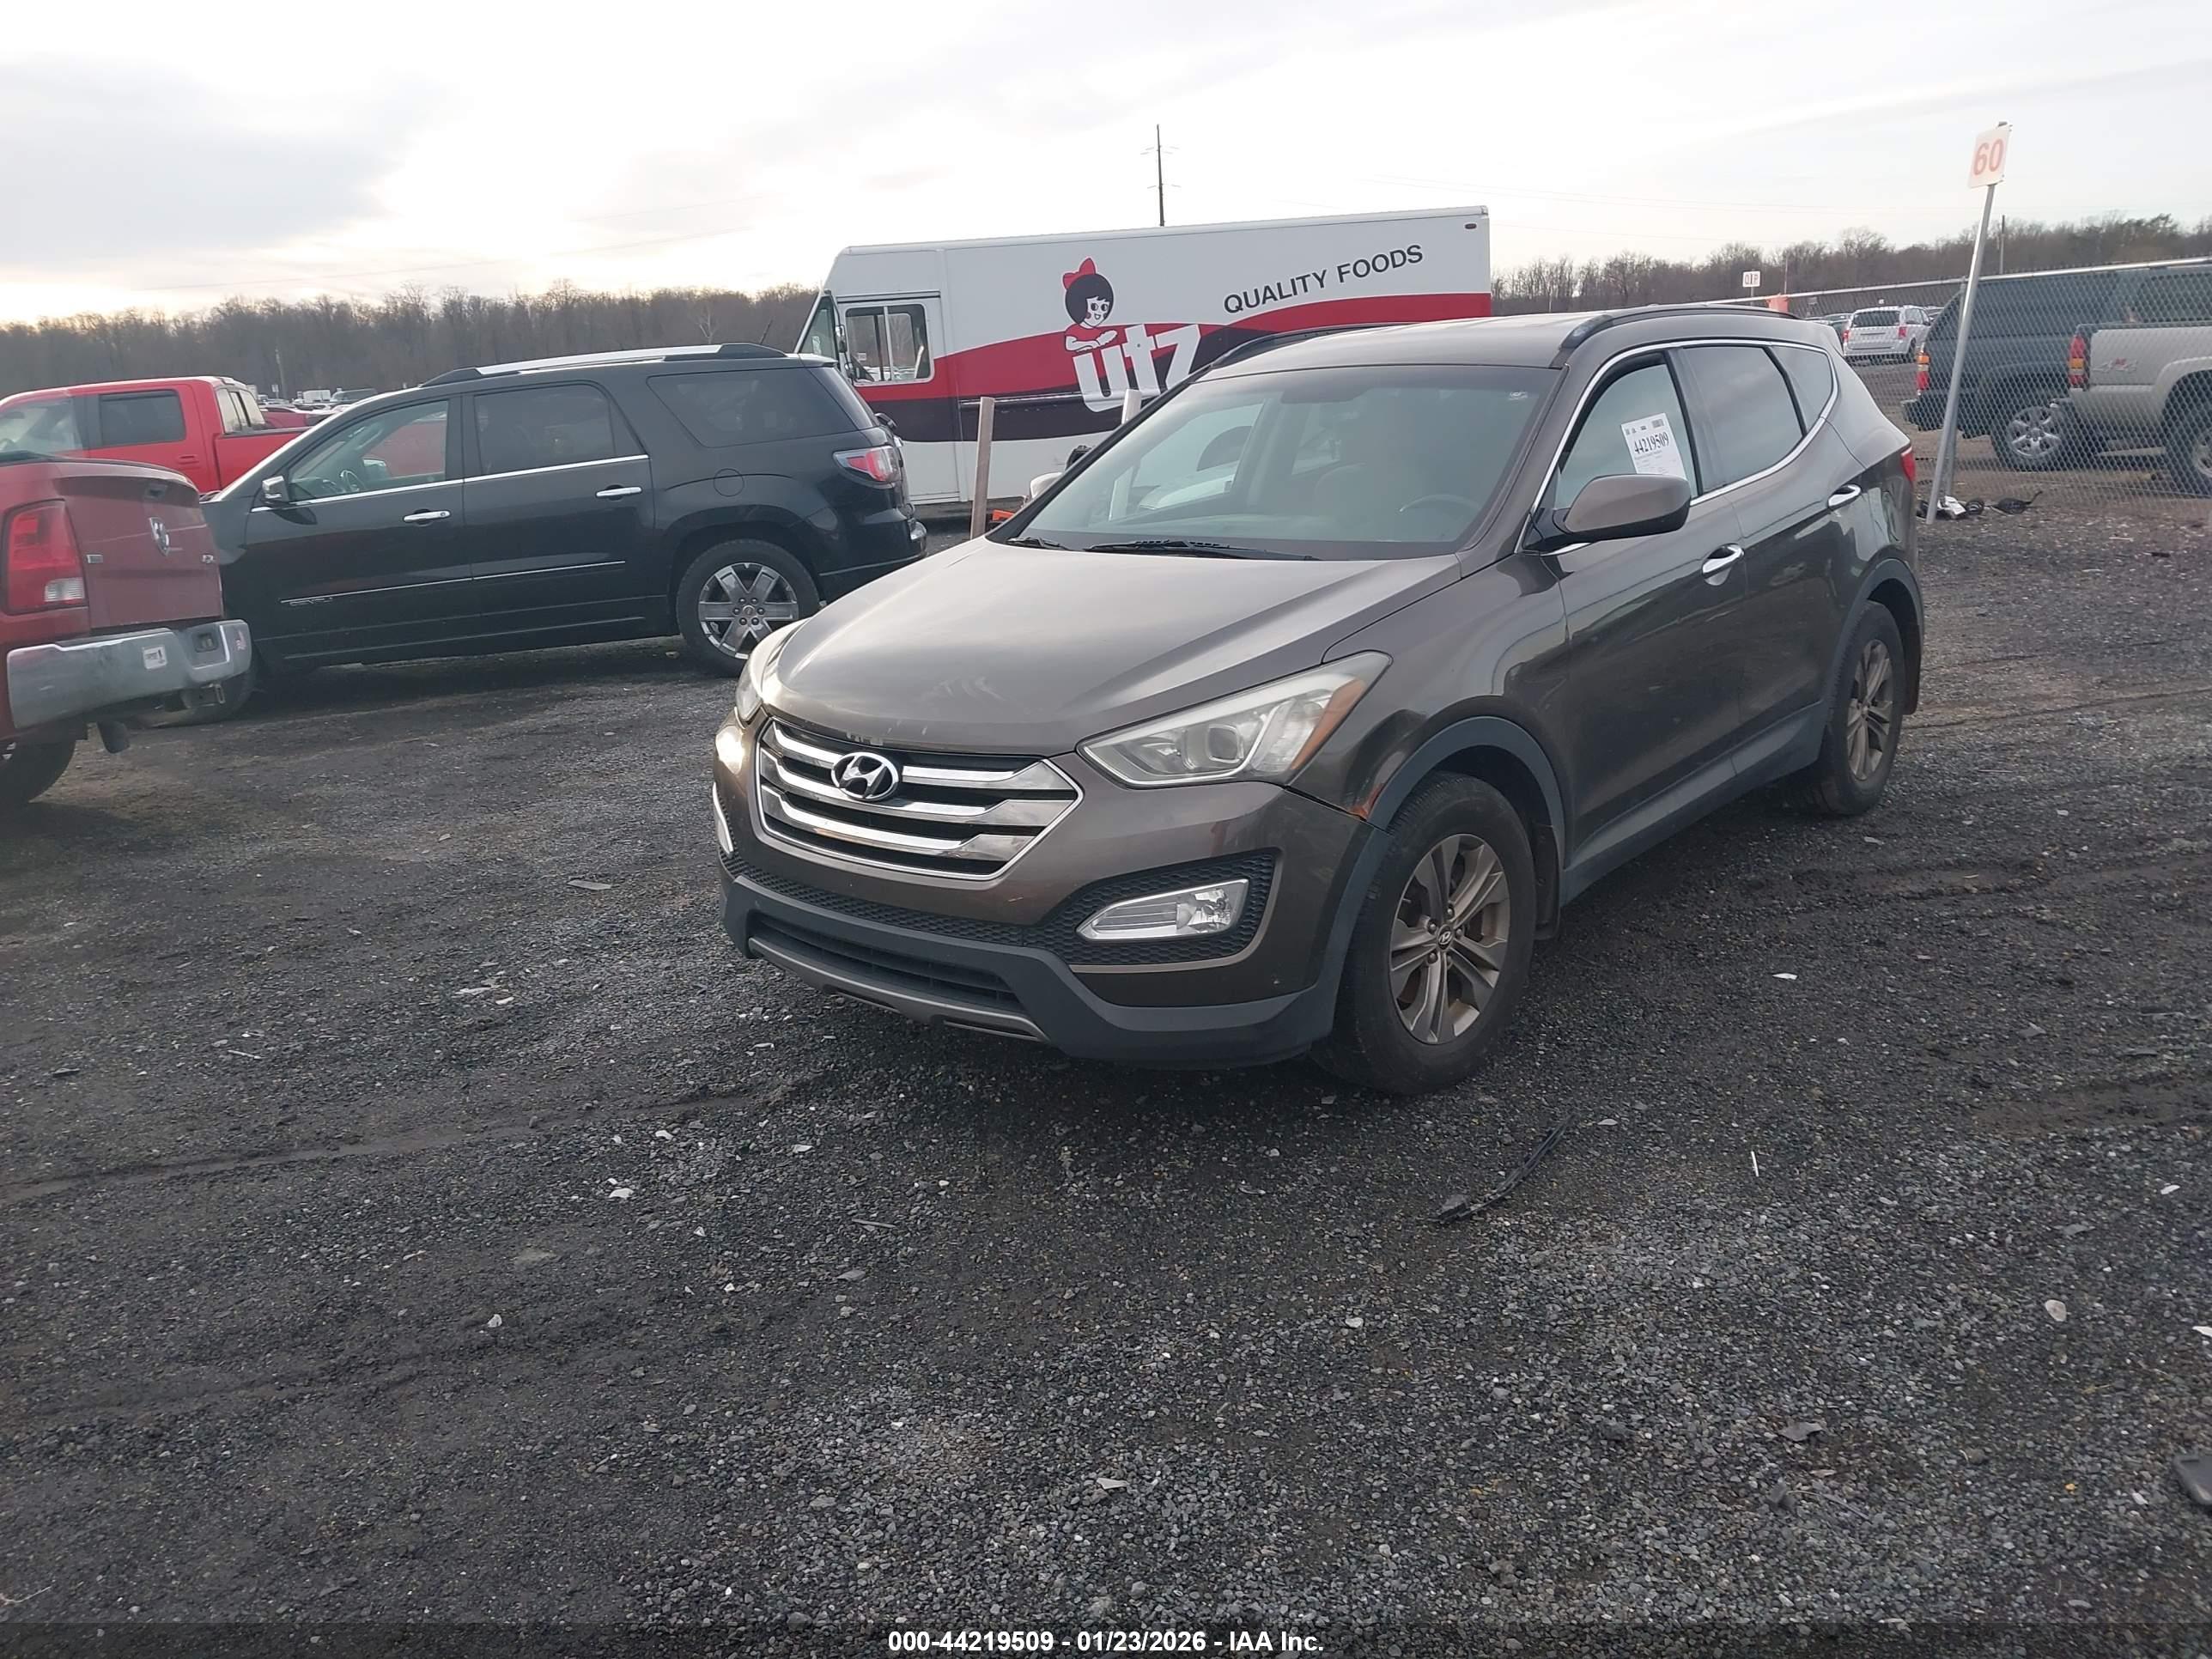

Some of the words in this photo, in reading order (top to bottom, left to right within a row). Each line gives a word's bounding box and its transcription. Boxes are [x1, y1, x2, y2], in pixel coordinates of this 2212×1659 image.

[1973, 139, 2003, 175] 60
[1224, 269, 1328, 313] QUALITY
[1336, 245, 1423, 283] FOODS
[1634, 431, 1670, 454] 44219509
